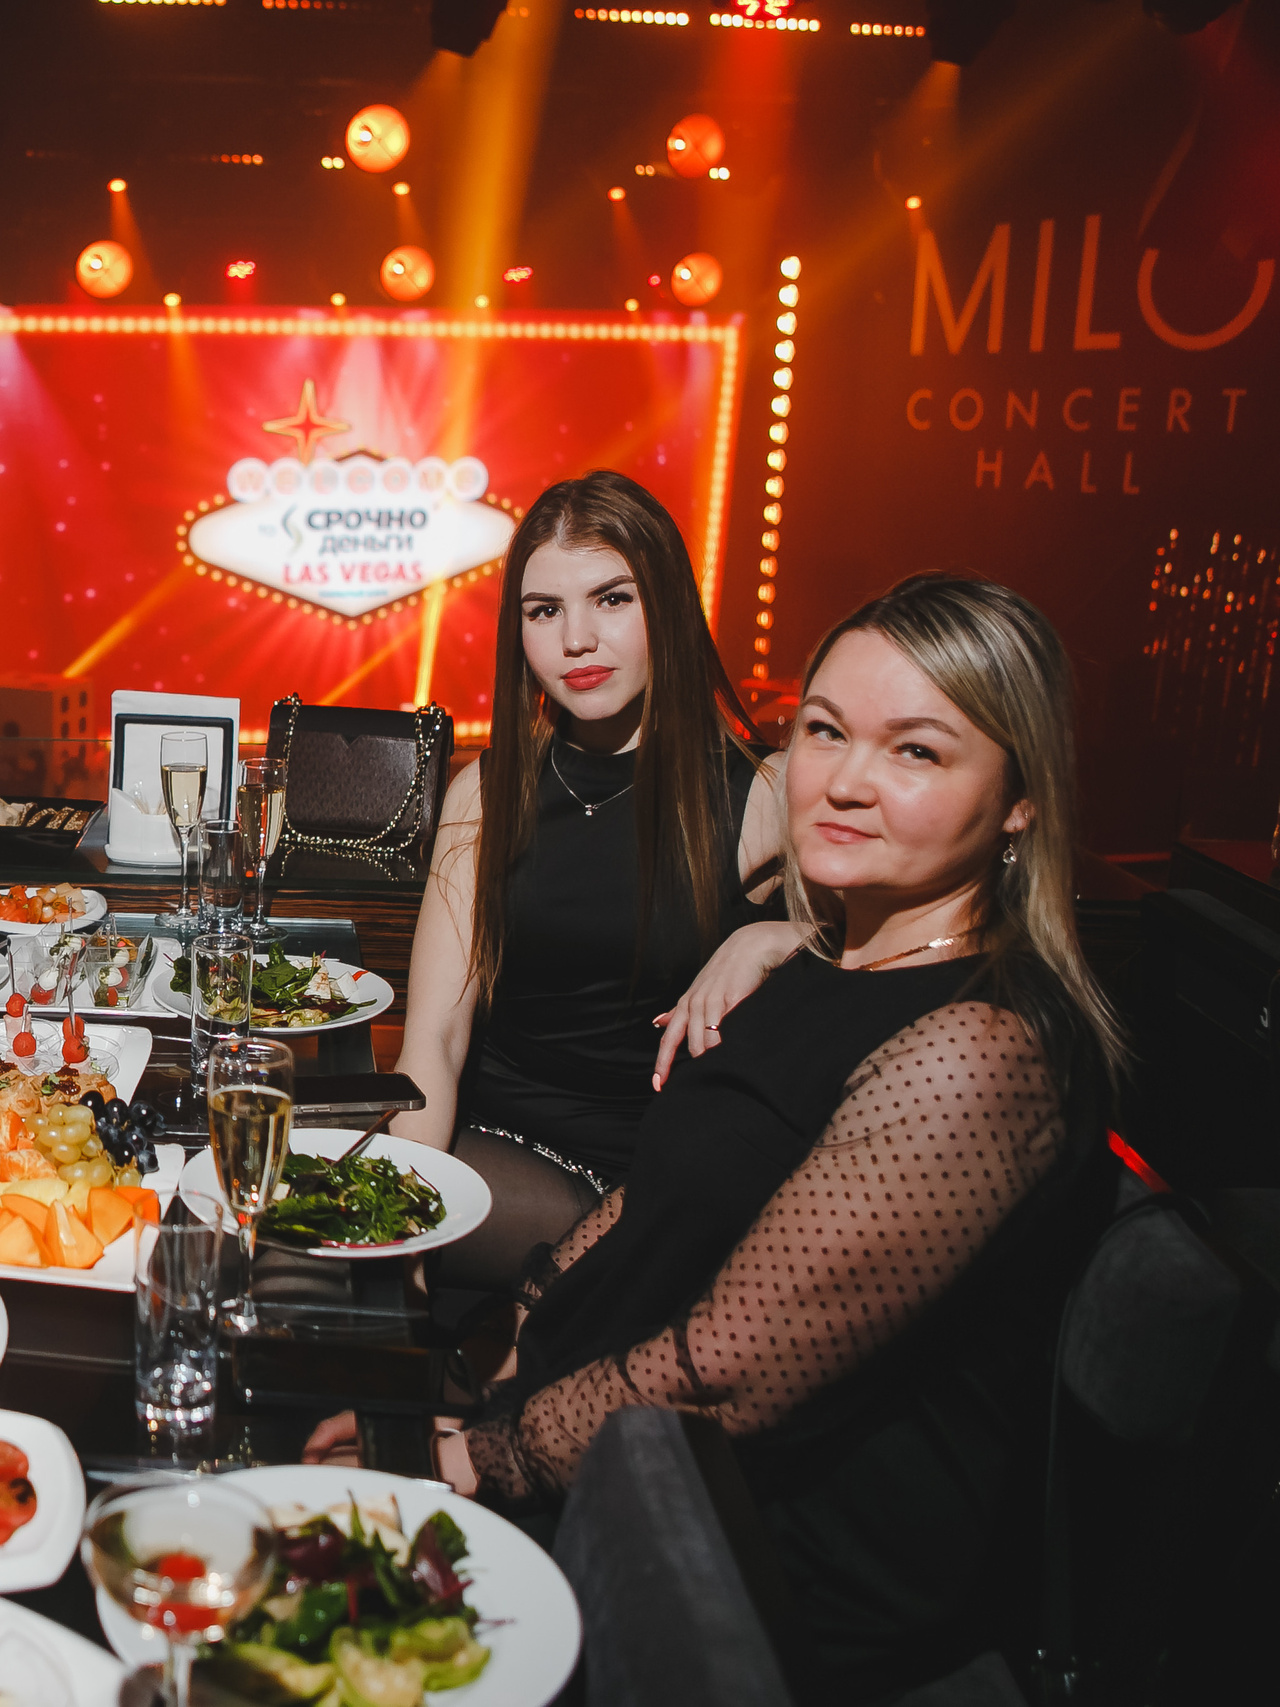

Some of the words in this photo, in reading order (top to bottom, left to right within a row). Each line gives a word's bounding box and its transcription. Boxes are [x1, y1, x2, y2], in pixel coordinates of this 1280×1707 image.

[909, 213, 1277, 357] MILO
[906, 387, 1247, 434] CONCERT
[975, 449, 1141, 495] HALL
[306, 508, 428, 531] СРОЧНО
[282, 563, 329, 584] LAS
[339, 562, 423, 584] VEGAS
